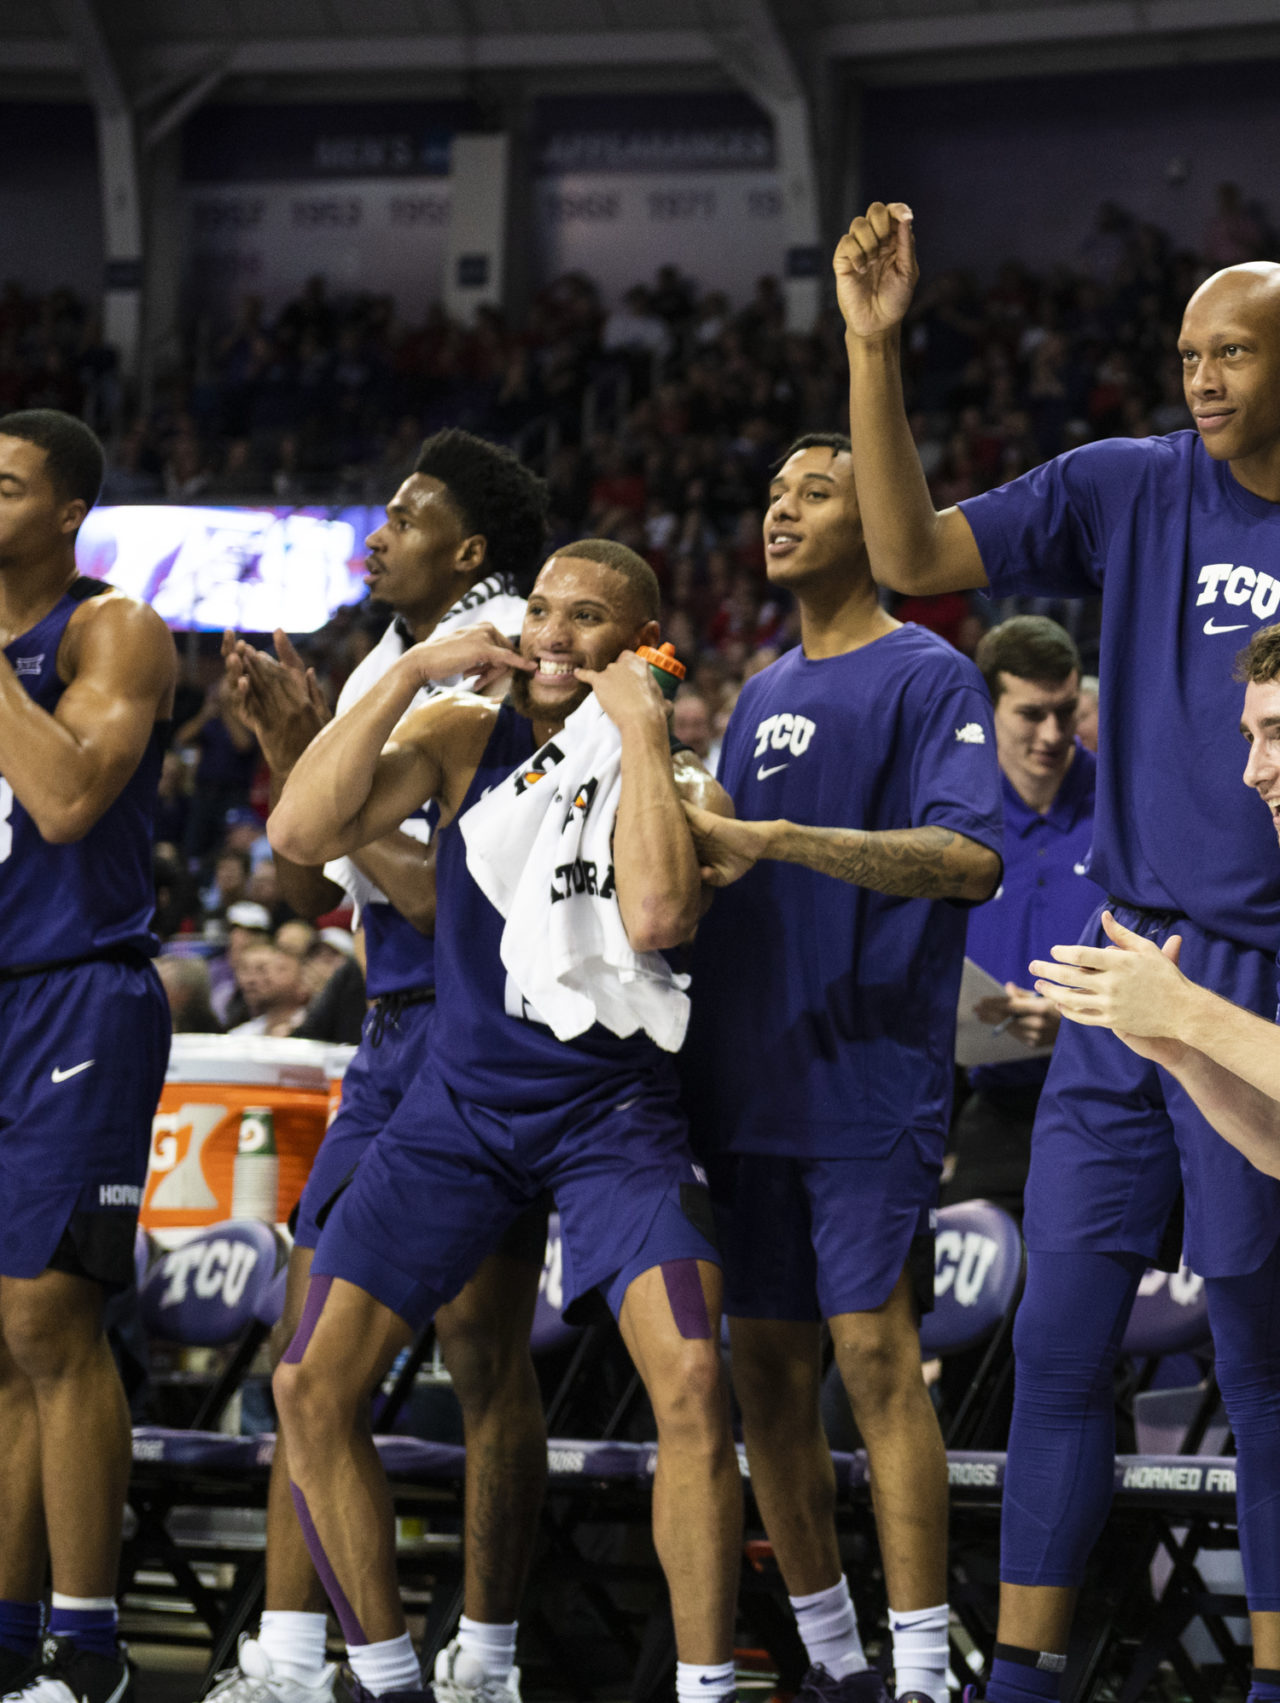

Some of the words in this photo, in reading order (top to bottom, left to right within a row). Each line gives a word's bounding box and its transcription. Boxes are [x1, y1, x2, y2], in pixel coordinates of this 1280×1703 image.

[755, 714, 816, 757] TCU
[162, 1239, 258, 1311] TCU
[934, 1230, 999, 1307] CU
[948, 1463, 998, 1486] ROGS
[1123, 1466, 1202, 1491] HORNED
[1205, 1469, 1237, 1492] FR
